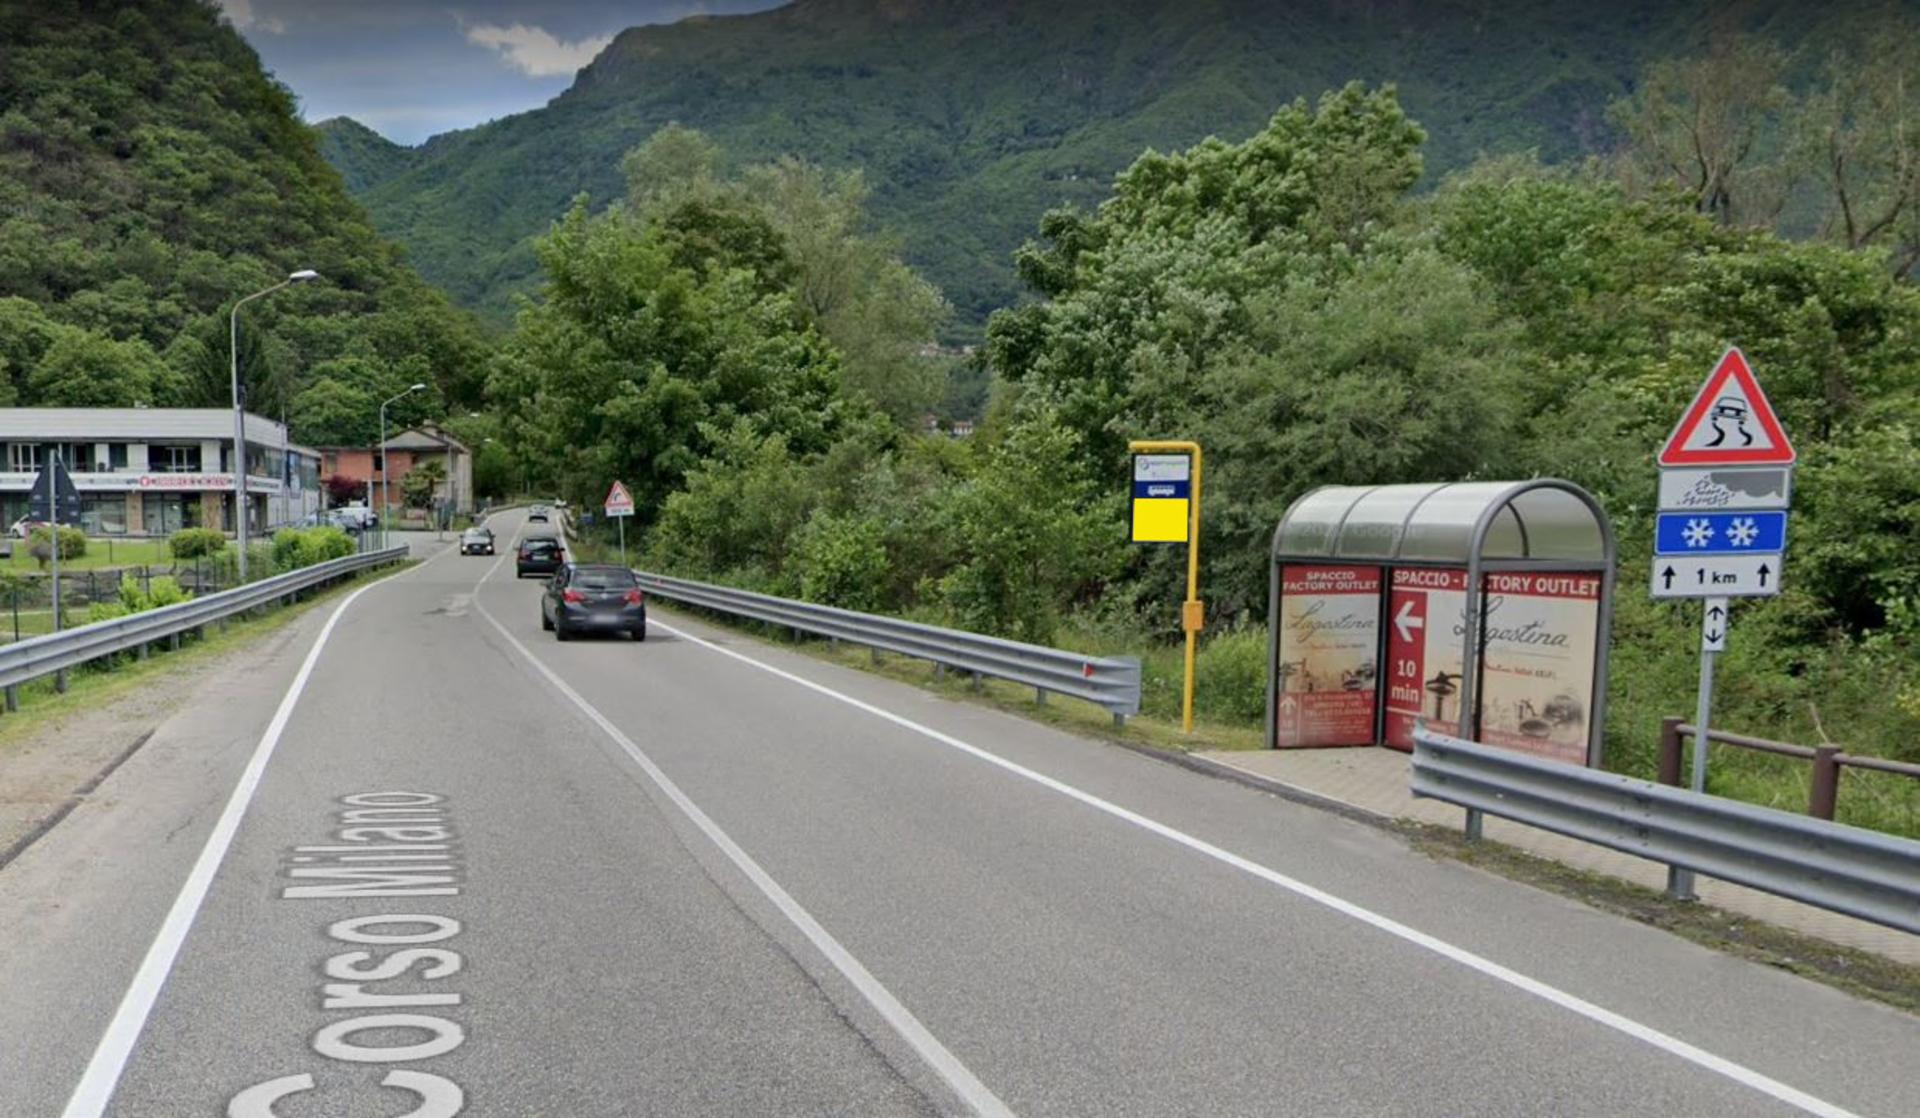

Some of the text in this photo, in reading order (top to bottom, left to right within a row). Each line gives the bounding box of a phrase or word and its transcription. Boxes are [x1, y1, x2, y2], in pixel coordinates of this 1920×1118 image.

[1307, 571, 1356, 580] SPACCIO
[1393, 570, 1449, 587] SPACCIO
[1535, 577, 1600, 596] OUTLET
[1697, 568, 1737, 584] 1 km
[1283, 581, 1379, 591] FACTORY OUTLET
[1397, 660, 1417, 677] 10
[1391, 683, 1419, 702] min
